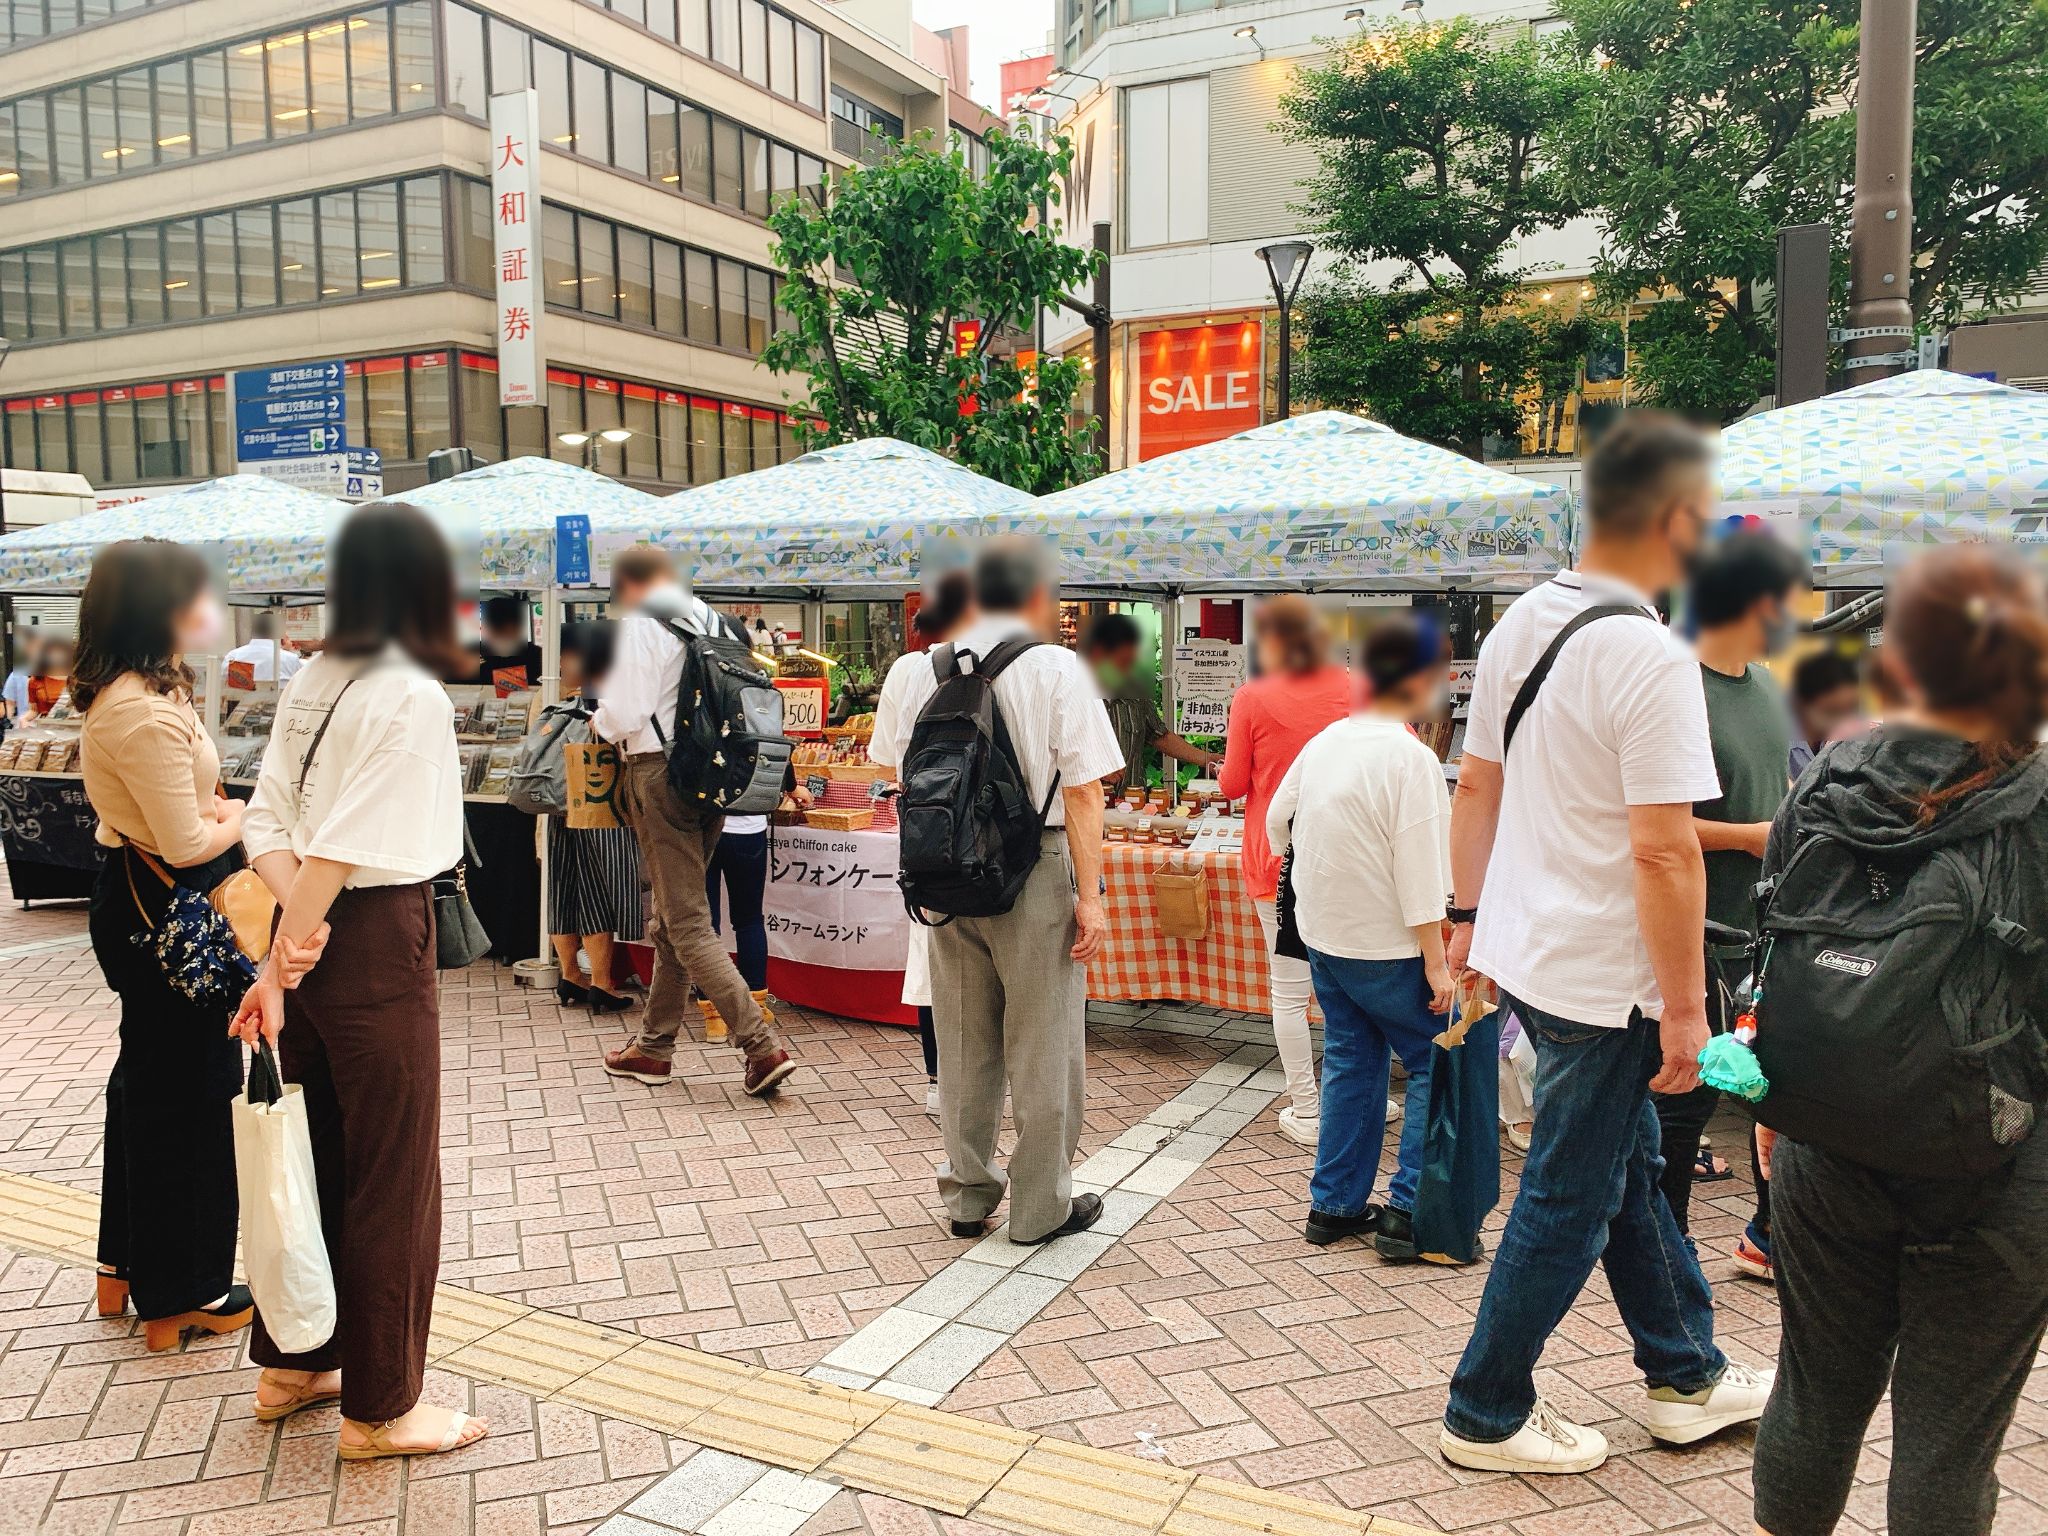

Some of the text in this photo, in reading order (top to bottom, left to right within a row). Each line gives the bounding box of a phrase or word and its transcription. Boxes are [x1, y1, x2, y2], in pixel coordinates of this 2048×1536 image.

[497, 135, 531, 342] 大和証券
[1147, 371, 1250, 415] SALE
[1309, 536, 1392, 553] FIELDOOR
[1187, 702, 1224, 716] 非加熱
[1180, 720, 1226, 734] はちみつ
[792, 838, 829, 851] Chiffon
[831, 841, 857, 853] cake
[771, 857, 894, 889] シフォンケー
[1821, 952, 1862, 970] Coleman
